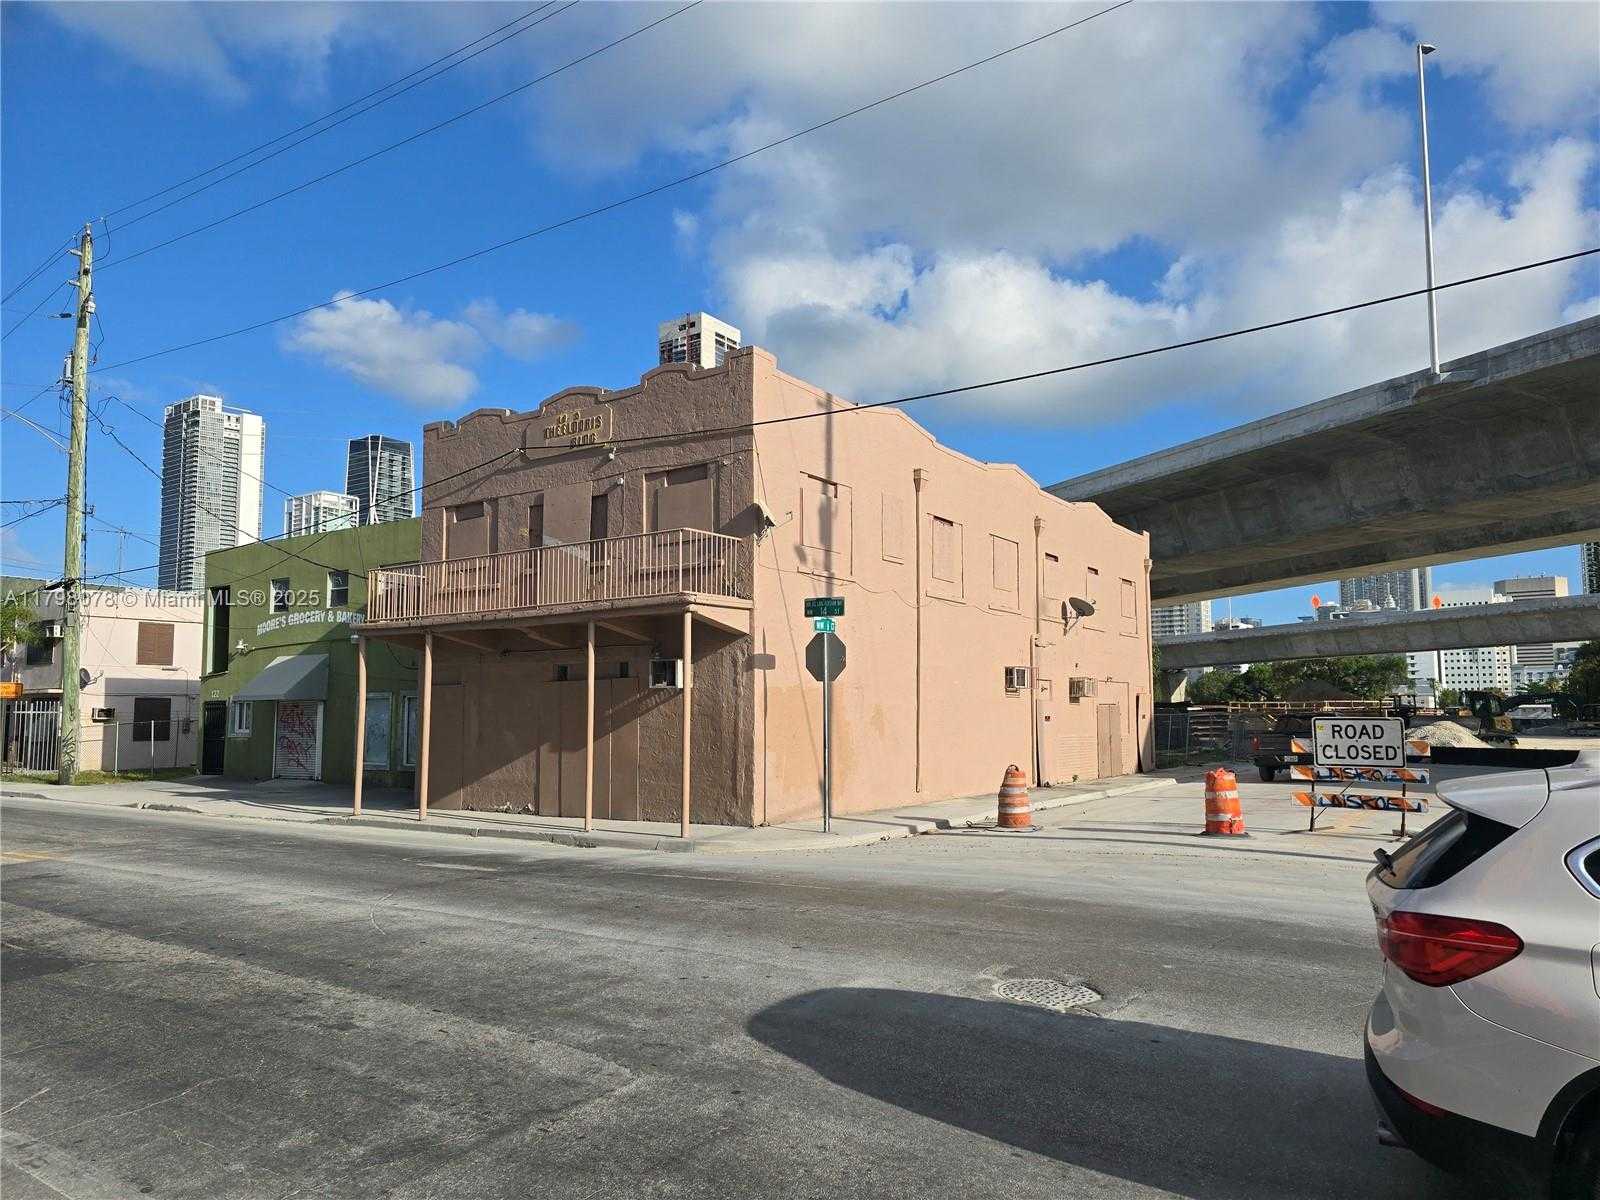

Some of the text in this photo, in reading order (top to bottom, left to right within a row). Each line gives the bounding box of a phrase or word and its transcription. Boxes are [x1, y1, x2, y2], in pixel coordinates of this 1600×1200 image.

[257, 610, 366, 636] MOORE'S GROCERY & BAKERY
[1331, 724, 1385, 740] ROAD
[1322, 744, 1398, 761] CLOSED
